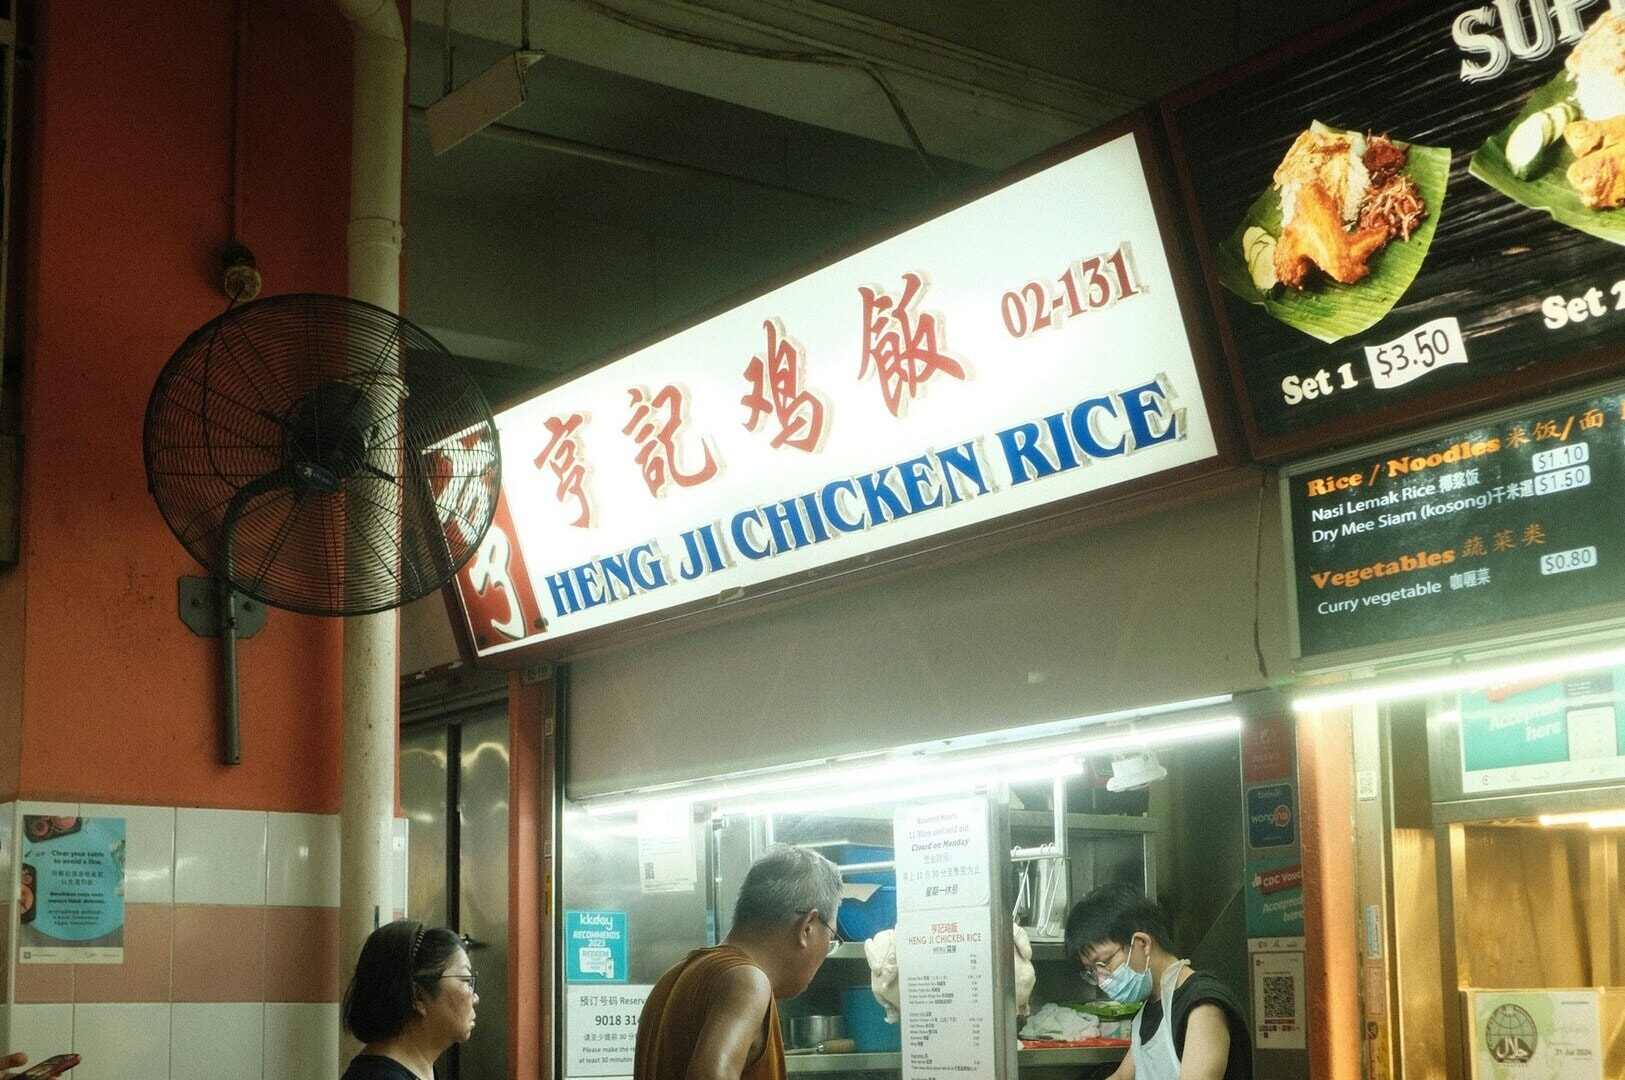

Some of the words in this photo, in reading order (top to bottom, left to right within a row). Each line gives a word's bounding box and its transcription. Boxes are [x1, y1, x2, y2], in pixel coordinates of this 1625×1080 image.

[1452, 0, 1622, 84] SUP
[1001, 247, 1140, 338] 02-131
[1542, 287, 1608, 330] Set
[1376, 329, 1450, 379] $3.50
[1281, 368, 1334, 405] Set
[1337, 362, 1359, 390] 1
[1307, 473, 1363, 498] Rice
[1368, 464, 1381, 487] /
[1387, 437, 1501, 478] Noodles
[1538, 446, 1584, 470] $1.10
[1539, 468, 1585, 492] $1.50
[544, 542, 668, 618] HENG
[680, 523, 727, 581] JI
[730, 442, 991, 560] CHICKEN
[995, 380, 1178, 487] RICE
[1312, 503, 1344, 522] Nasi
[1347, 491, 1400, 514] Lemak
[1402, 484, 1436, 501] Rice
[1312, 527, 1339, 543] Dry
[1341, 519, 1375, 537] Mee
[1378, 510, 1418, 528] Siam
[1310, 549, 1456, 589] Vegetables
[1545, 549, 1592, 572] $0.80
[1317, 597, 1359, 615] Curry
[1362, 581, 1442, 607] vegetable
[942, 838, 969, 849] Monday
[1263, 875, 1281, 887] CDC
[573, 930, 621, 940] RECOMMENDS
[579, 913, 614, 931] kkday
[908, 935, 927, 945] HENG
[935, 933, 965, 943] CHICKEN
[966, 932, 982, 942] RICE
[588, 939, 606, 947] 2023
[595, 1014, 622, 1026] 9018
